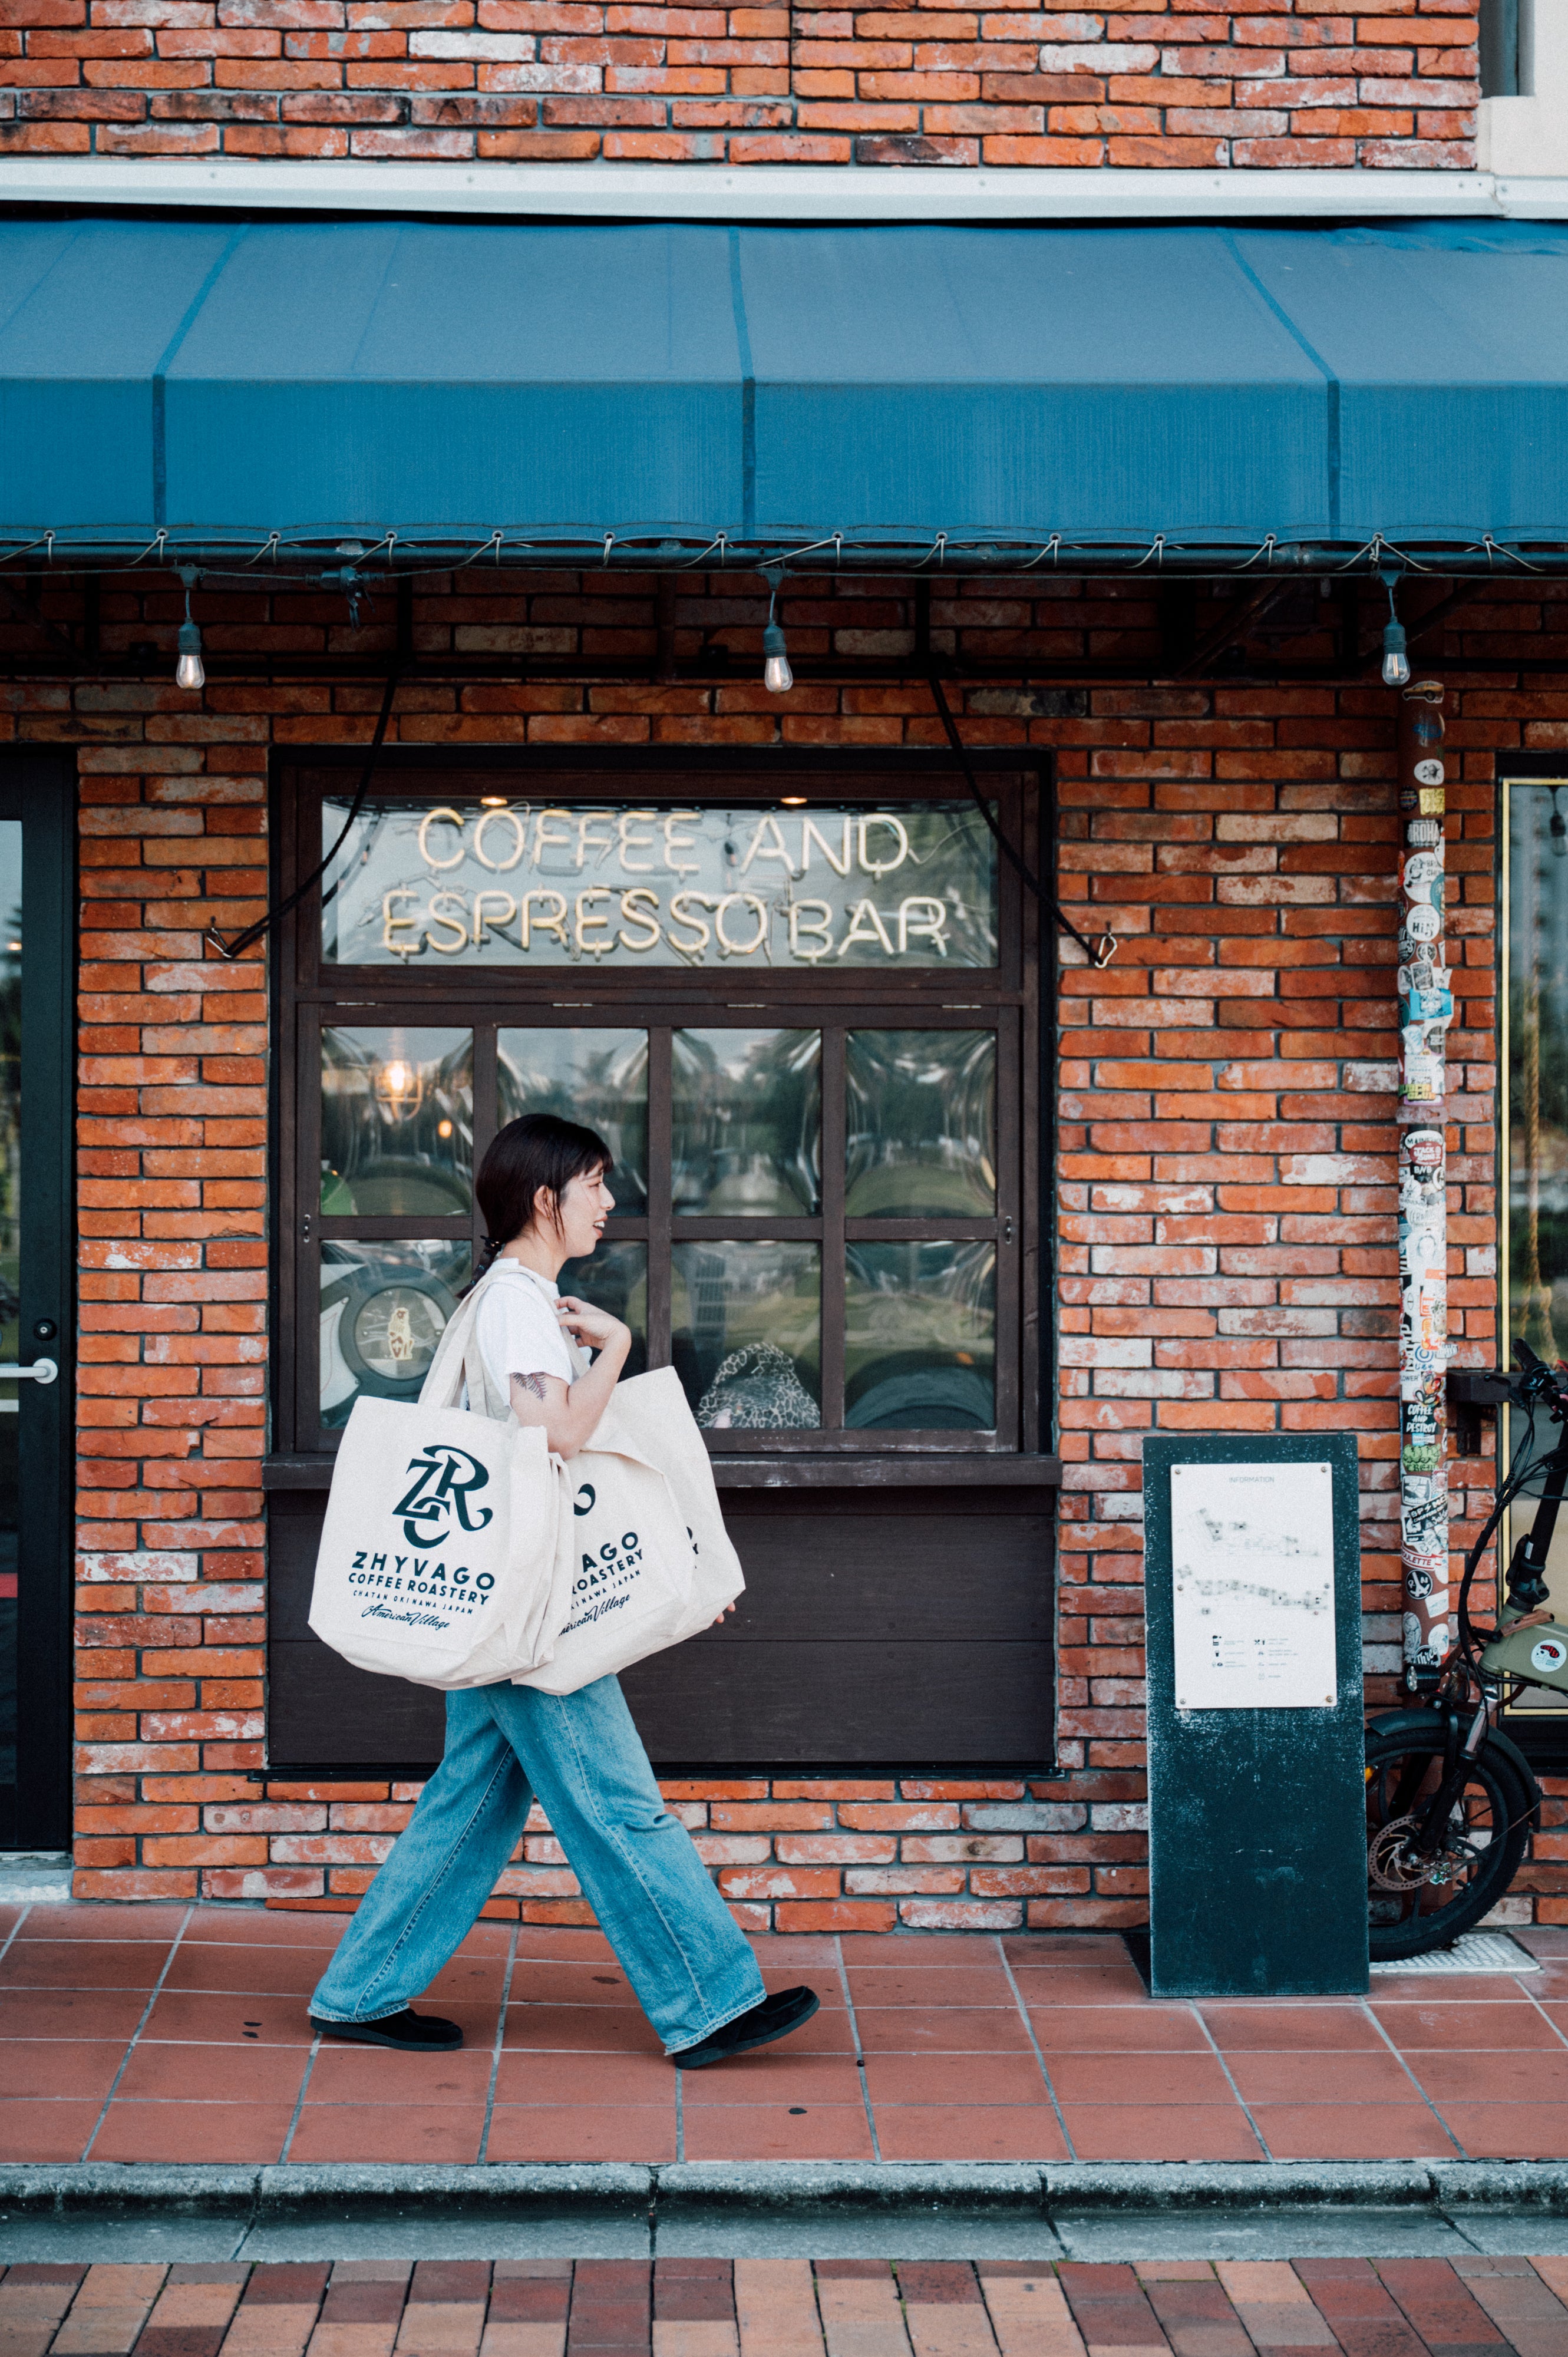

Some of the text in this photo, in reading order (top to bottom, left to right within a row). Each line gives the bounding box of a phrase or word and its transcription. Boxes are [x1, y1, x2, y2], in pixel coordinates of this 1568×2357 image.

[418, 808, 909, 876] COFFEE AND
[383, 888, 947, 958] ESPRESSO BAR
[1407, 1404, 1433, 1415] COFFEE
[1406, 1422, 1437, 1432] DESTROY
[352, 1551, 495, 1590] ZHYVAGO
[613, 1570, 641, 1588] JAPAN
[349, 1573, 489, 1605] COFFEE ROASTERY
[354, 1590, 473, 1614] CHATAN OKINAWA JAPAN
